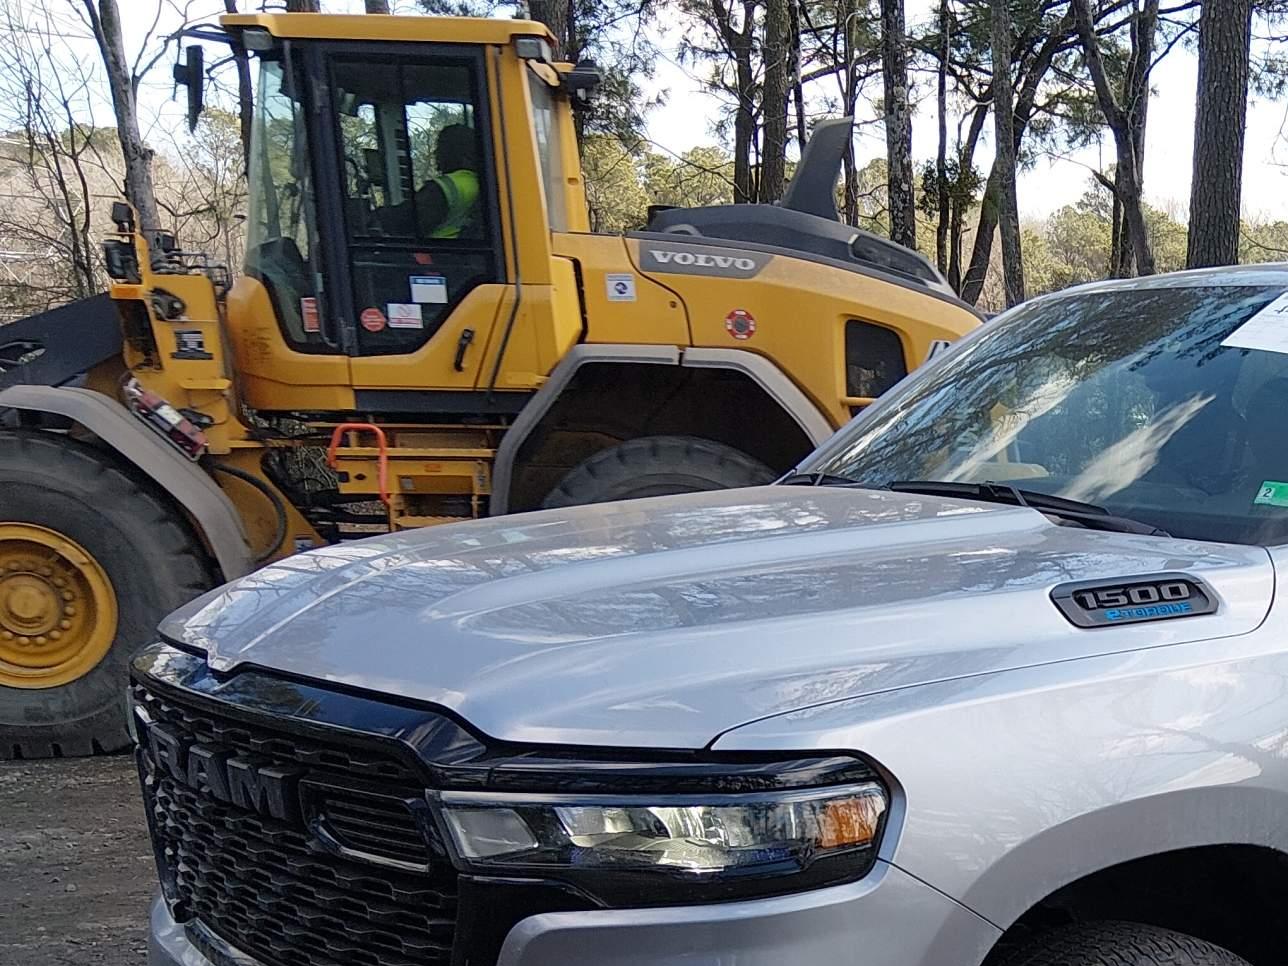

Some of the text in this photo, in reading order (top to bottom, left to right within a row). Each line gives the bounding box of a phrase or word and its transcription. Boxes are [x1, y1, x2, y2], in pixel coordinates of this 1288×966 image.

[649, 250, 756, 271] VOLVO
[1263, 487, 1273, 498] 2
[1080, 583, 1191, 609] 1500
[149, 722, 289, 820] RAM
